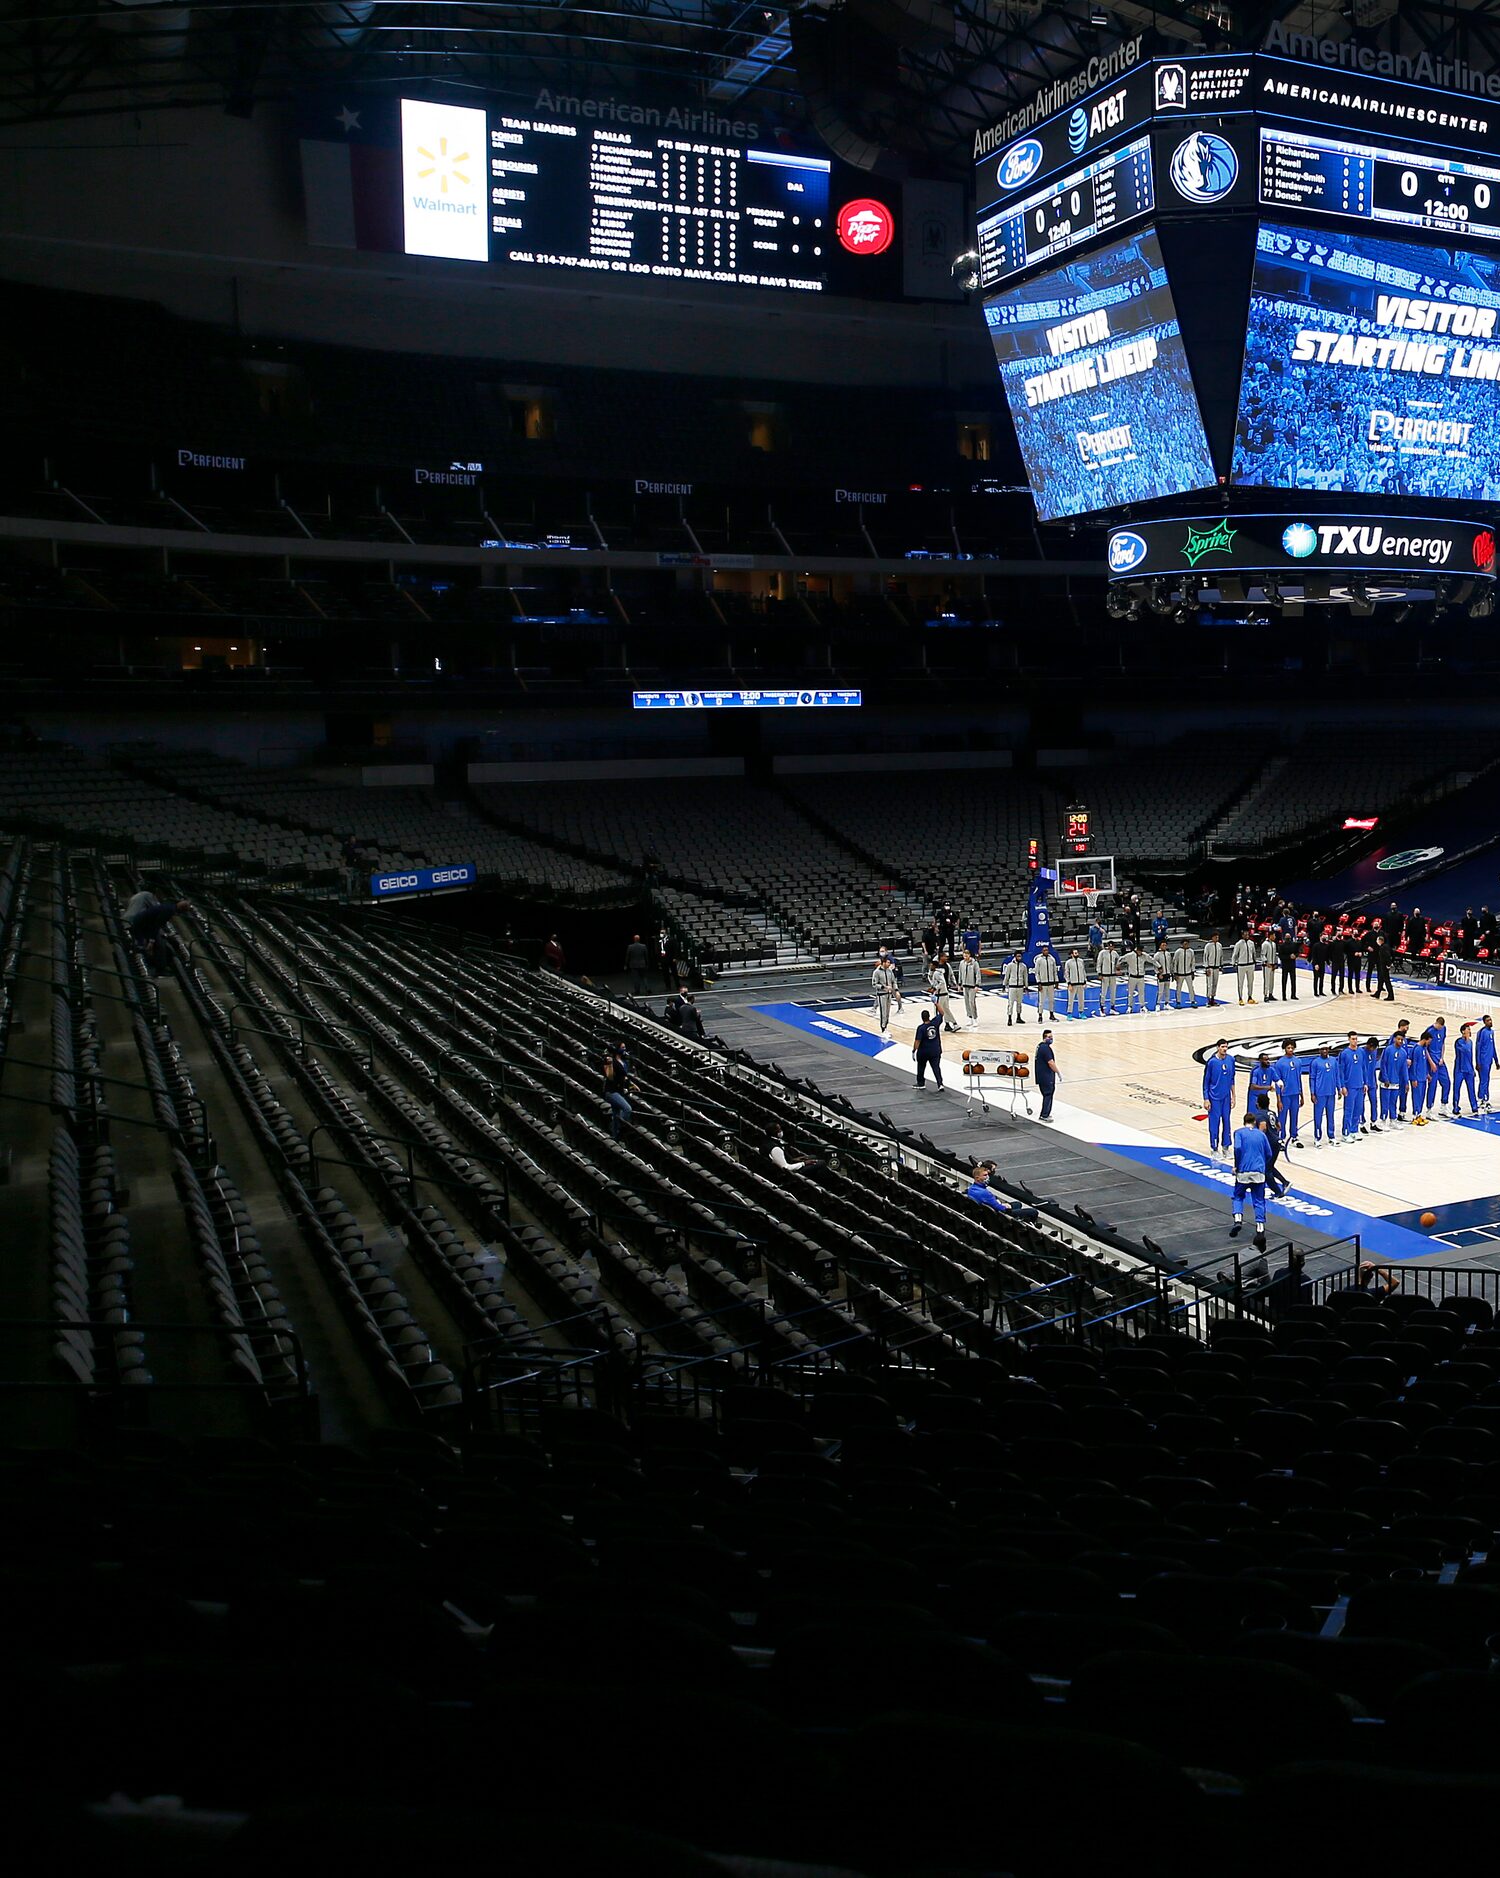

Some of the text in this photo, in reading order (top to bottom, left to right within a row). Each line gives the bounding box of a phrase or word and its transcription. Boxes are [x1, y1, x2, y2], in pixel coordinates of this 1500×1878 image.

[1190, 68, 1250, 81] AMERICAN
[1190, 79, 1244, 90] AIRLINES
[973, 33, 1143, 160] AmericanAirlinesCenter
[1263, 78, 1489, 133] AMERICANAIRLINESCENTER
[534, 88, 760, 140] American Airlines
[1089, 89, 1127, 139] AT&T
[501, 117, 577, 137] TEAM LEADERS
[593, 130, 632, 144] DALLAS
[657, 139, 673, 149] PTS
[693, 144, 709, 154] AST
[711, 146, 725, 156] STL
[726, 149, 740, 159] FLS
[1275, 145, 1320, 161] Richardson
[1005, 146, 1036, 184] Ford
[1266, 155, 1271, 164] 7
[1275, 156, 1302, 169] Powell
[1264, 167, 1273, 176] 10
[1275, 168, 1326, 184] Finney-Smith
[787, 182, 804, 192] DAL
[1263, 189, 1273, 198] 77
[1275, 190, 1302, 202] Doncic
[1264, 178, 1273, 187] 11
[1275, 179, 1313, 194] Hardaway
[1400, 171, 1491, 209] 0 0
[413, 196, 478, 215] Walmart
[693, 207, 708, 217] AST
[746, 207, 785, 219] PERSONAL
[1035, 191, 1081, 233] 0 0
[1424, 199, 1469, 221] 12:00
[792, 216, 800, 225] 0
[814, 219, 822, 228] 0
[848, 221, 881, 236] Pizza
[1047, 220, 1072, 243] 12:00
[753, 241, 821, 256] SCORE 0 0
[853, 232, 879, 245] Hut
[509, 251, 823, 291] CALL 214-747-MAVS OR LOG ONTO MAVS.COM FOR MAVS TICKETS
[1377, 294, 1498, 338] VISITOR
[1046, 308, 1111, 357] VISITOR
[1292, 329, 1449, 375] STARTING
[1024, 337, 1158, 408] STARTING LINEUP
[1368, 410, 1475, 445] PERFICIENT
[1076, 425, 1133, 462] PERFICIENT
[178, 449, 247, 470] PERFICIENT
[415, 468, 477, 486] PERFICIENT
[635, 480, 693, 495] PERFICIENT
[835, 489, 888, 504] PERFICIENT
[1111, 537, 1136, 564] Ford
[1189, 532, 1230, 554] Sprite
[1069, 814, 1088, 823] 12:00
[1068, 823, 1086, 836] 24
[379, 869, 468, 890] GEICO GEICO
[1445, 963, 1495, 991] PERFICIENT
